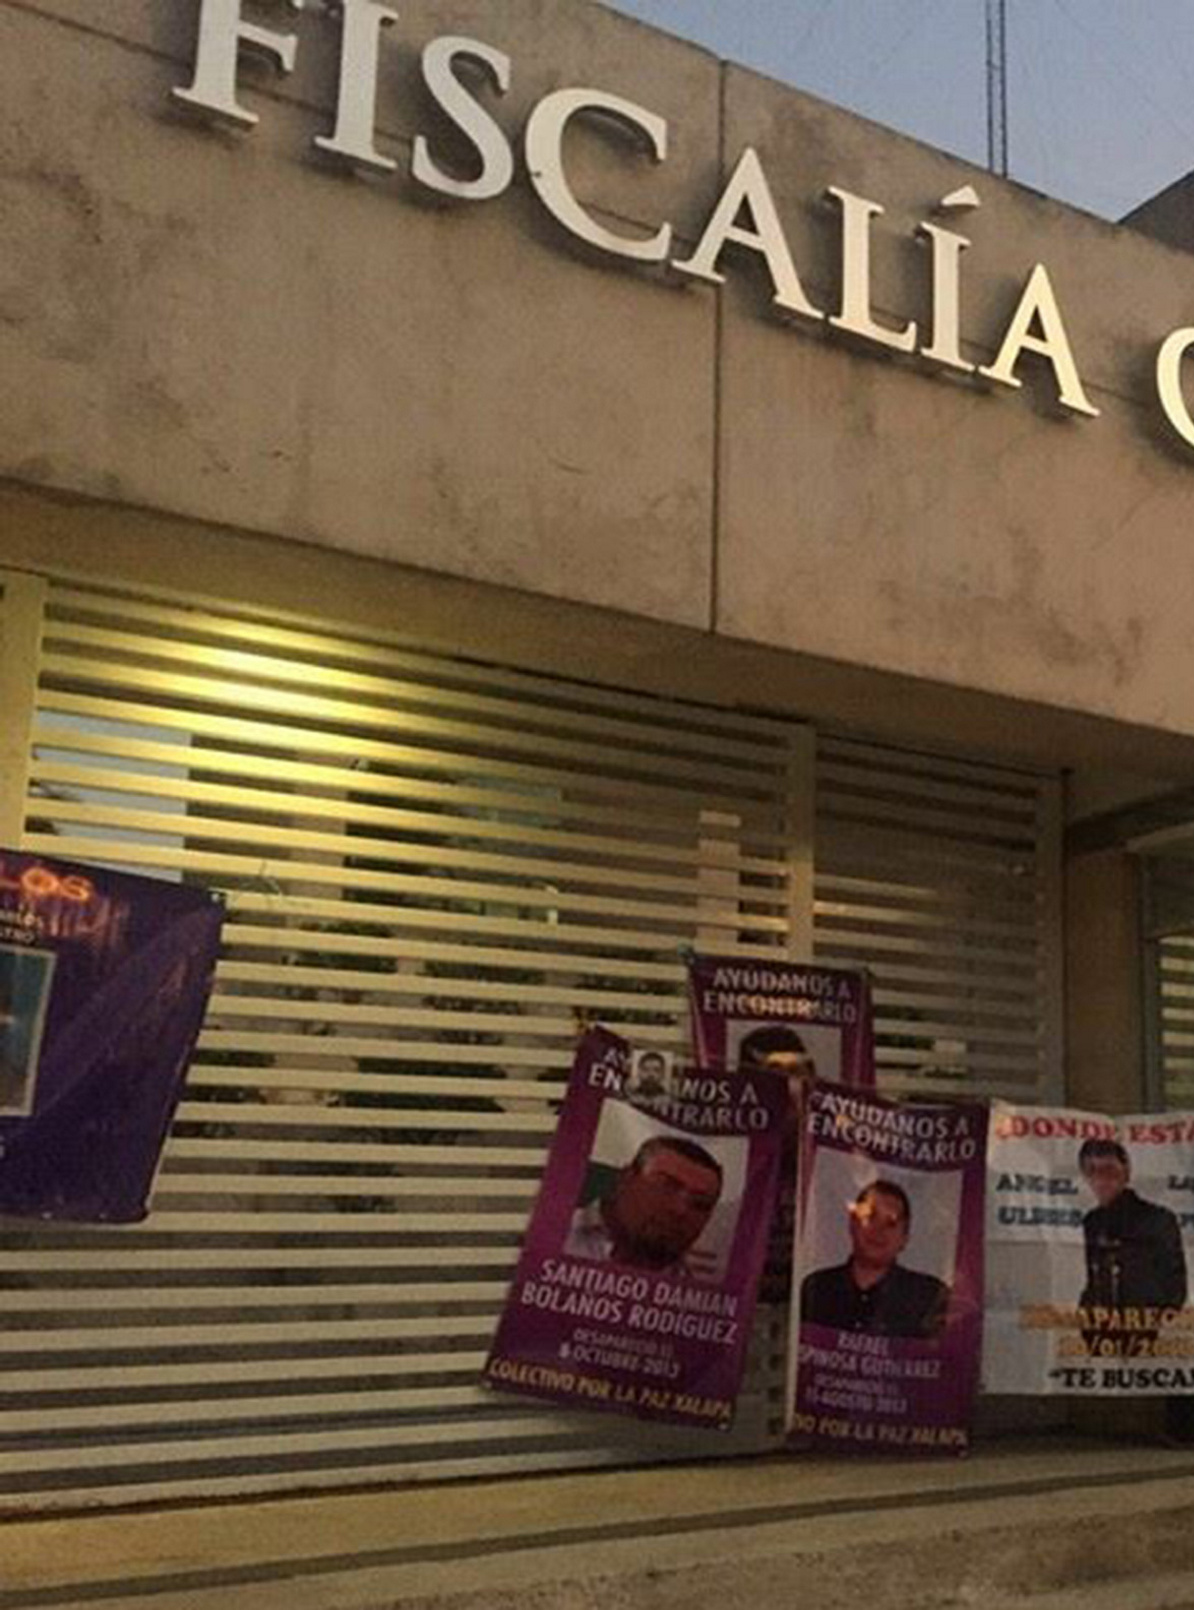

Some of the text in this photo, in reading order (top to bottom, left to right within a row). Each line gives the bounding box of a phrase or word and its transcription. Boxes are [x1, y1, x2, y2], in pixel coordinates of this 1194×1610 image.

[171, 0, 1100, 416] FISCALÍA
[540, 1258, 648, 1301] SANTIAGO
[489, 1358, 576, 1390] COLECTIVO
[576, 1376, 612, 1400] POR
[614, 1384, 638, 1402] LA
